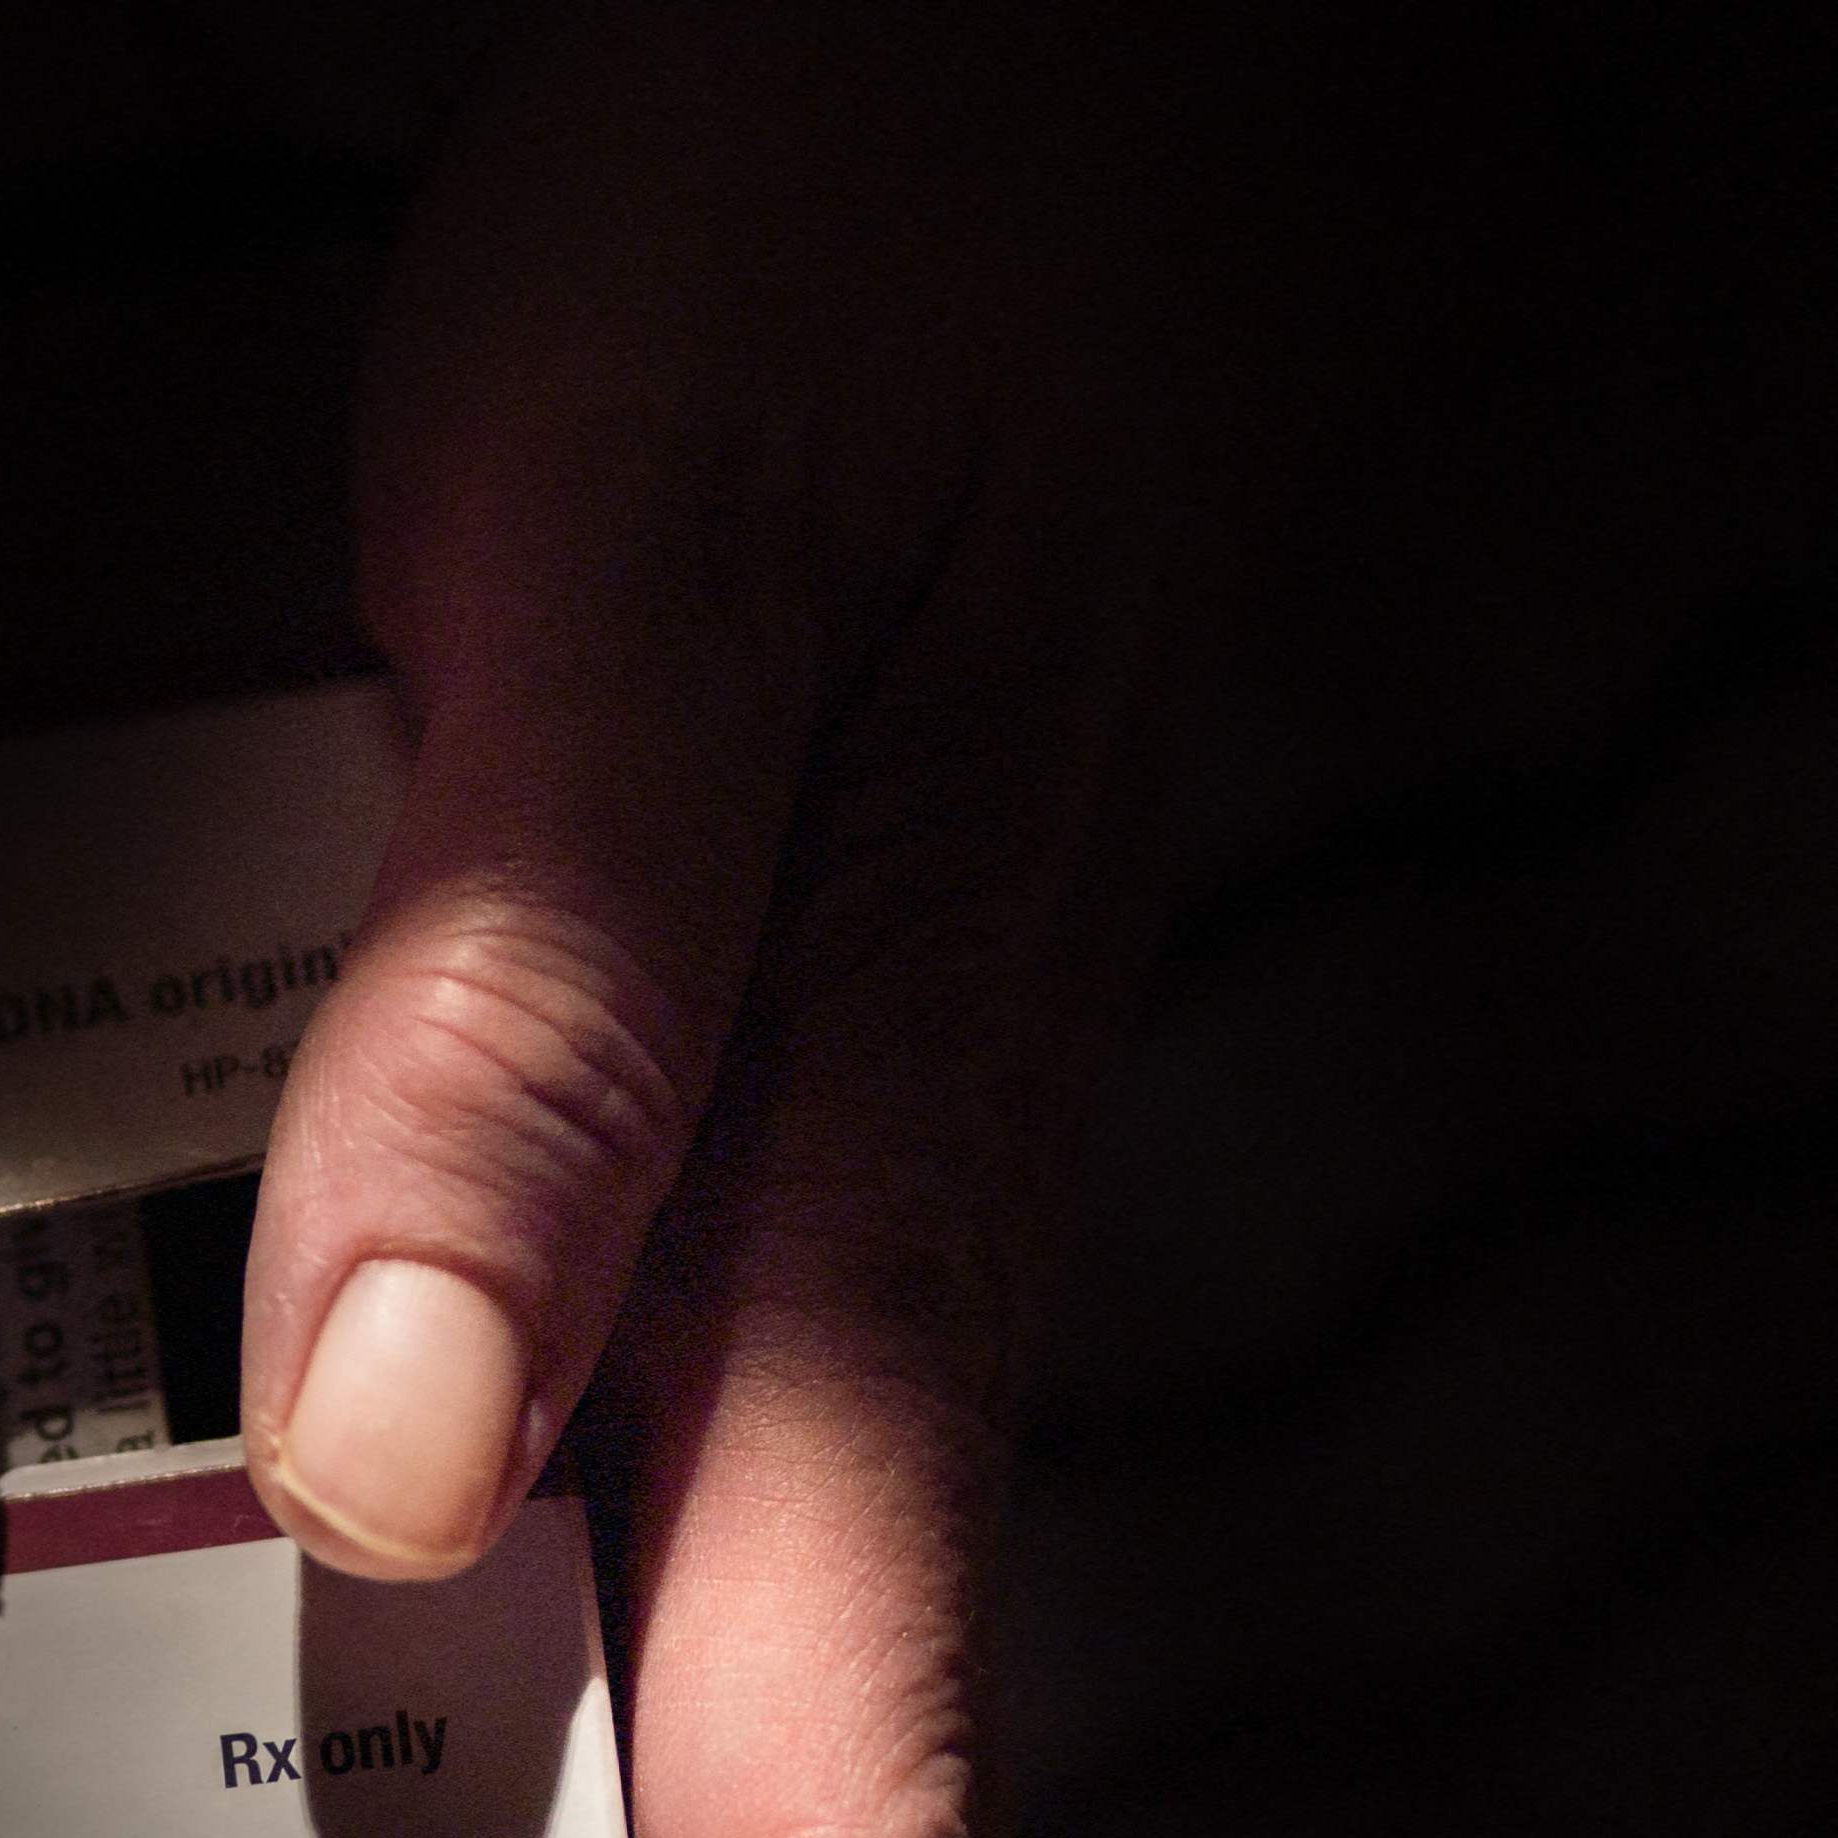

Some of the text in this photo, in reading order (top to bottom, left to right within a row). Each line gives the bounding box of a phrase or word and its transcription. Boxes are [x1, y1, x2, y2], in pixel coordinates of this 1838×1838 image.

[151, 931, 353, 1016] origin
[179, 1038, 299, 1097] HP-8
[220, 1710, 447, 1788] Rx only
